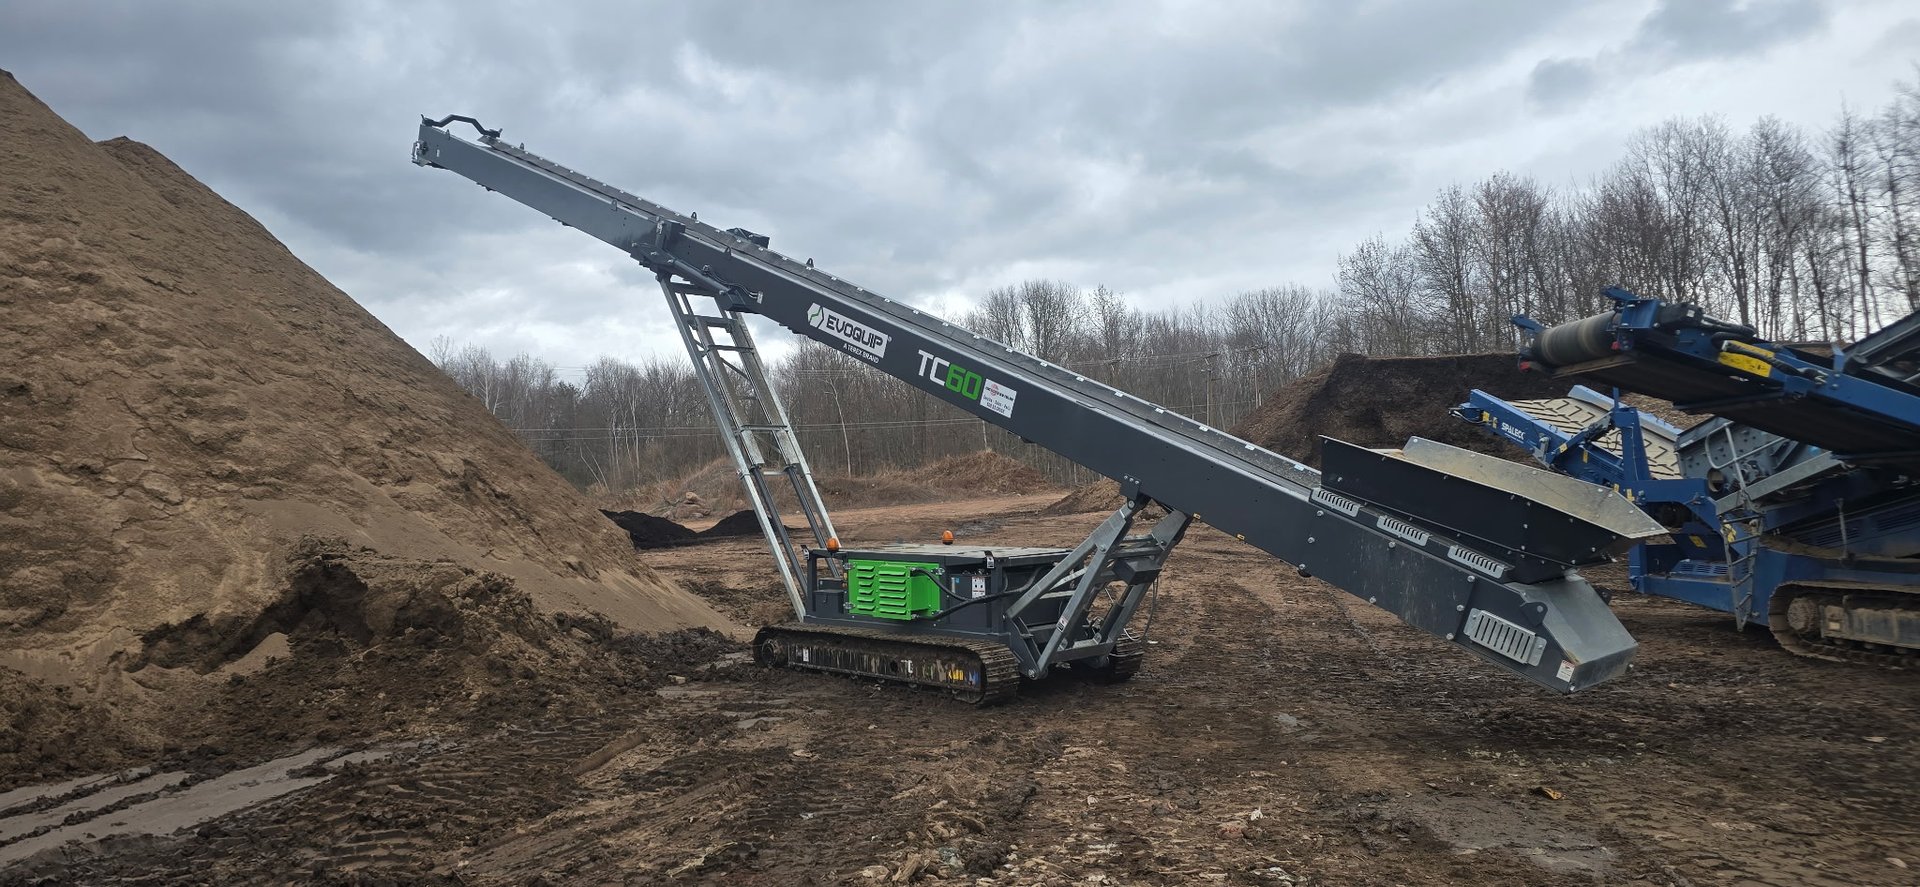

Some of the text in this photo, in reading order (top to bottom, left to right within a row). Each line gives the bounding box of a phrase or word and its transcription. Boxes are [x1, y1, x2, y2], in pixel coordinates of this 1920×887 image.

[826, 314, 883, 349] EVOQUIP
[862, 351, 880, 364] BRAND
[918, 349, 982, 400] TC60
